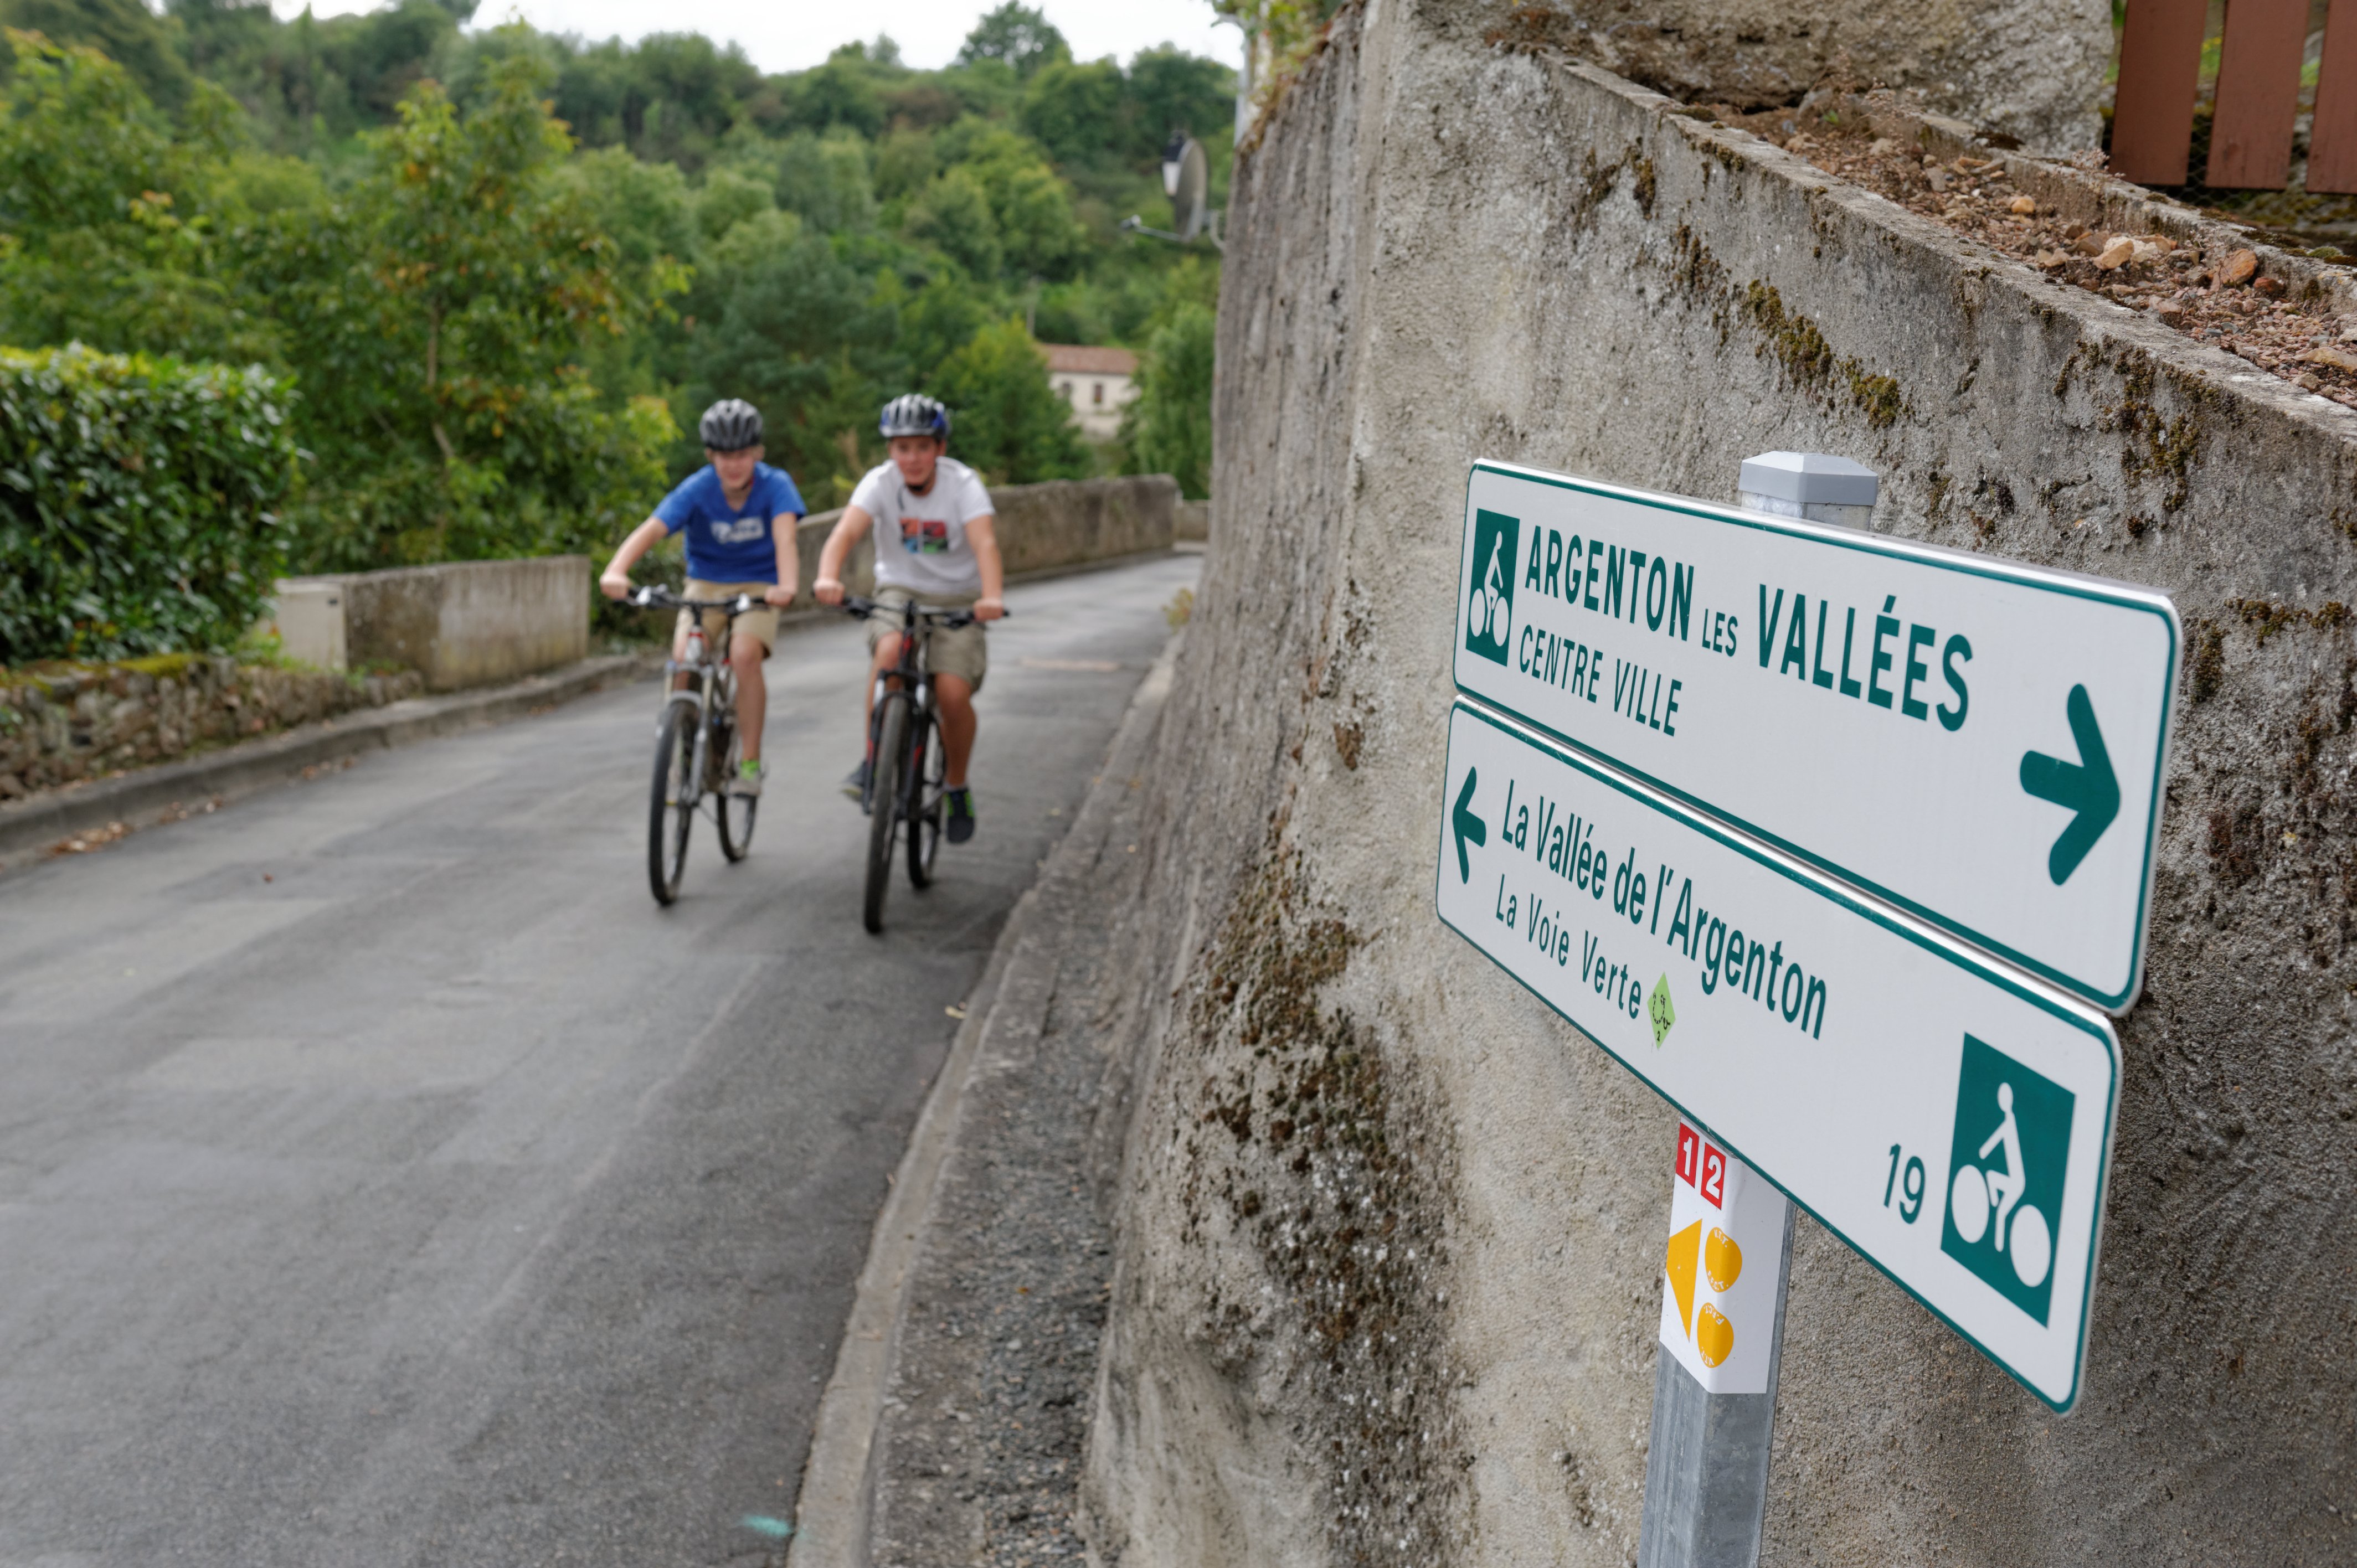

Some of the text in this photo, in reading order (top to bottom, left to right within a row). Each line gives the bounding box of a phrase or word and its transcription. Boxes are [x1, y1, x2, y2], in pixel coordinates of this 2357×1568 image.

[1520, 624, 1682, 737] CENTRE VILLE
[1525, 525, 1973, 732] ARGENTON LES VALLÉES
[1496, 874, 1641, 1019] La Voie Verte
[1502, 779, 1826, 1040] La Vallée de l'Argenton
[1683, 1136, 1722, 1200] 1 2
[1883, 1143, 1926, 1225] 19
